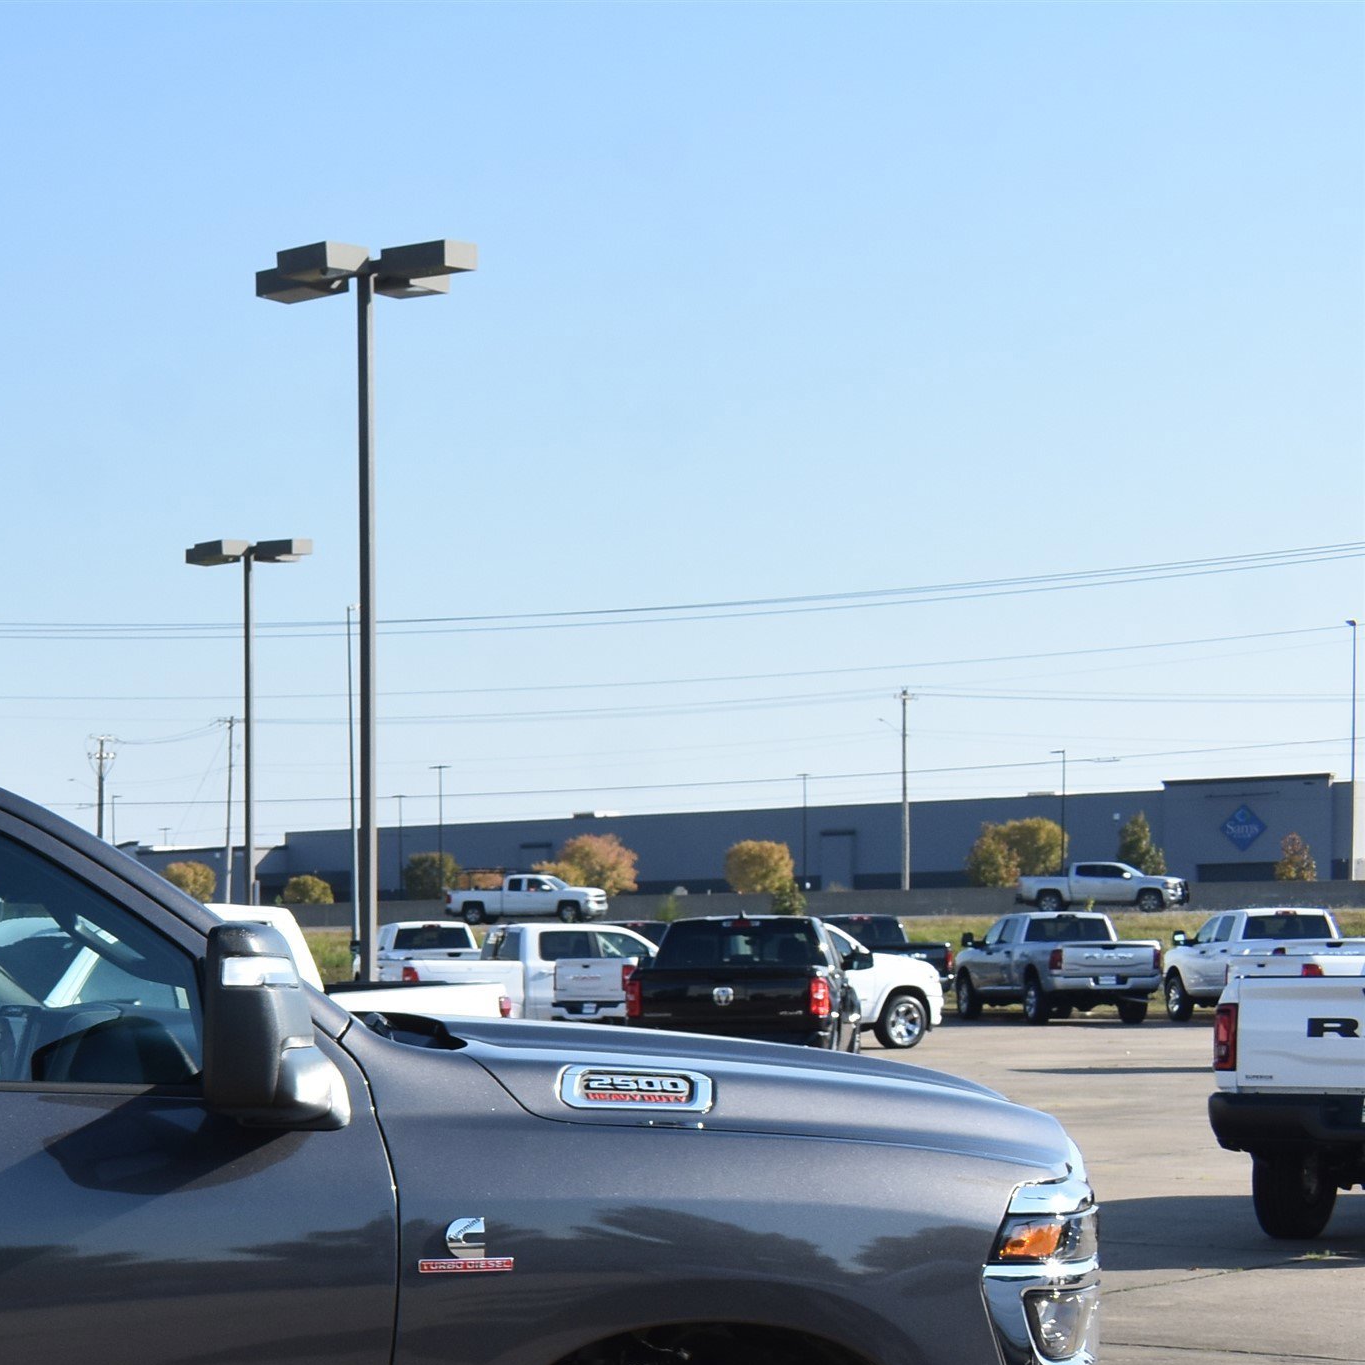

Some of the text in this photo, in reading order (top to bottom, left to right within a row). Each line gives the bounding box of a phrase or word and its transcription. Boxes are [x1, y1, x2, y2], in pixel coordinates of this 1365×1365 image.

[584, 1076, 687, 1093] 2500
[585, 1093, 686, 1103] HEAVY DUTY
[422, 1259, 511, 1270] TURBO DIESEL
